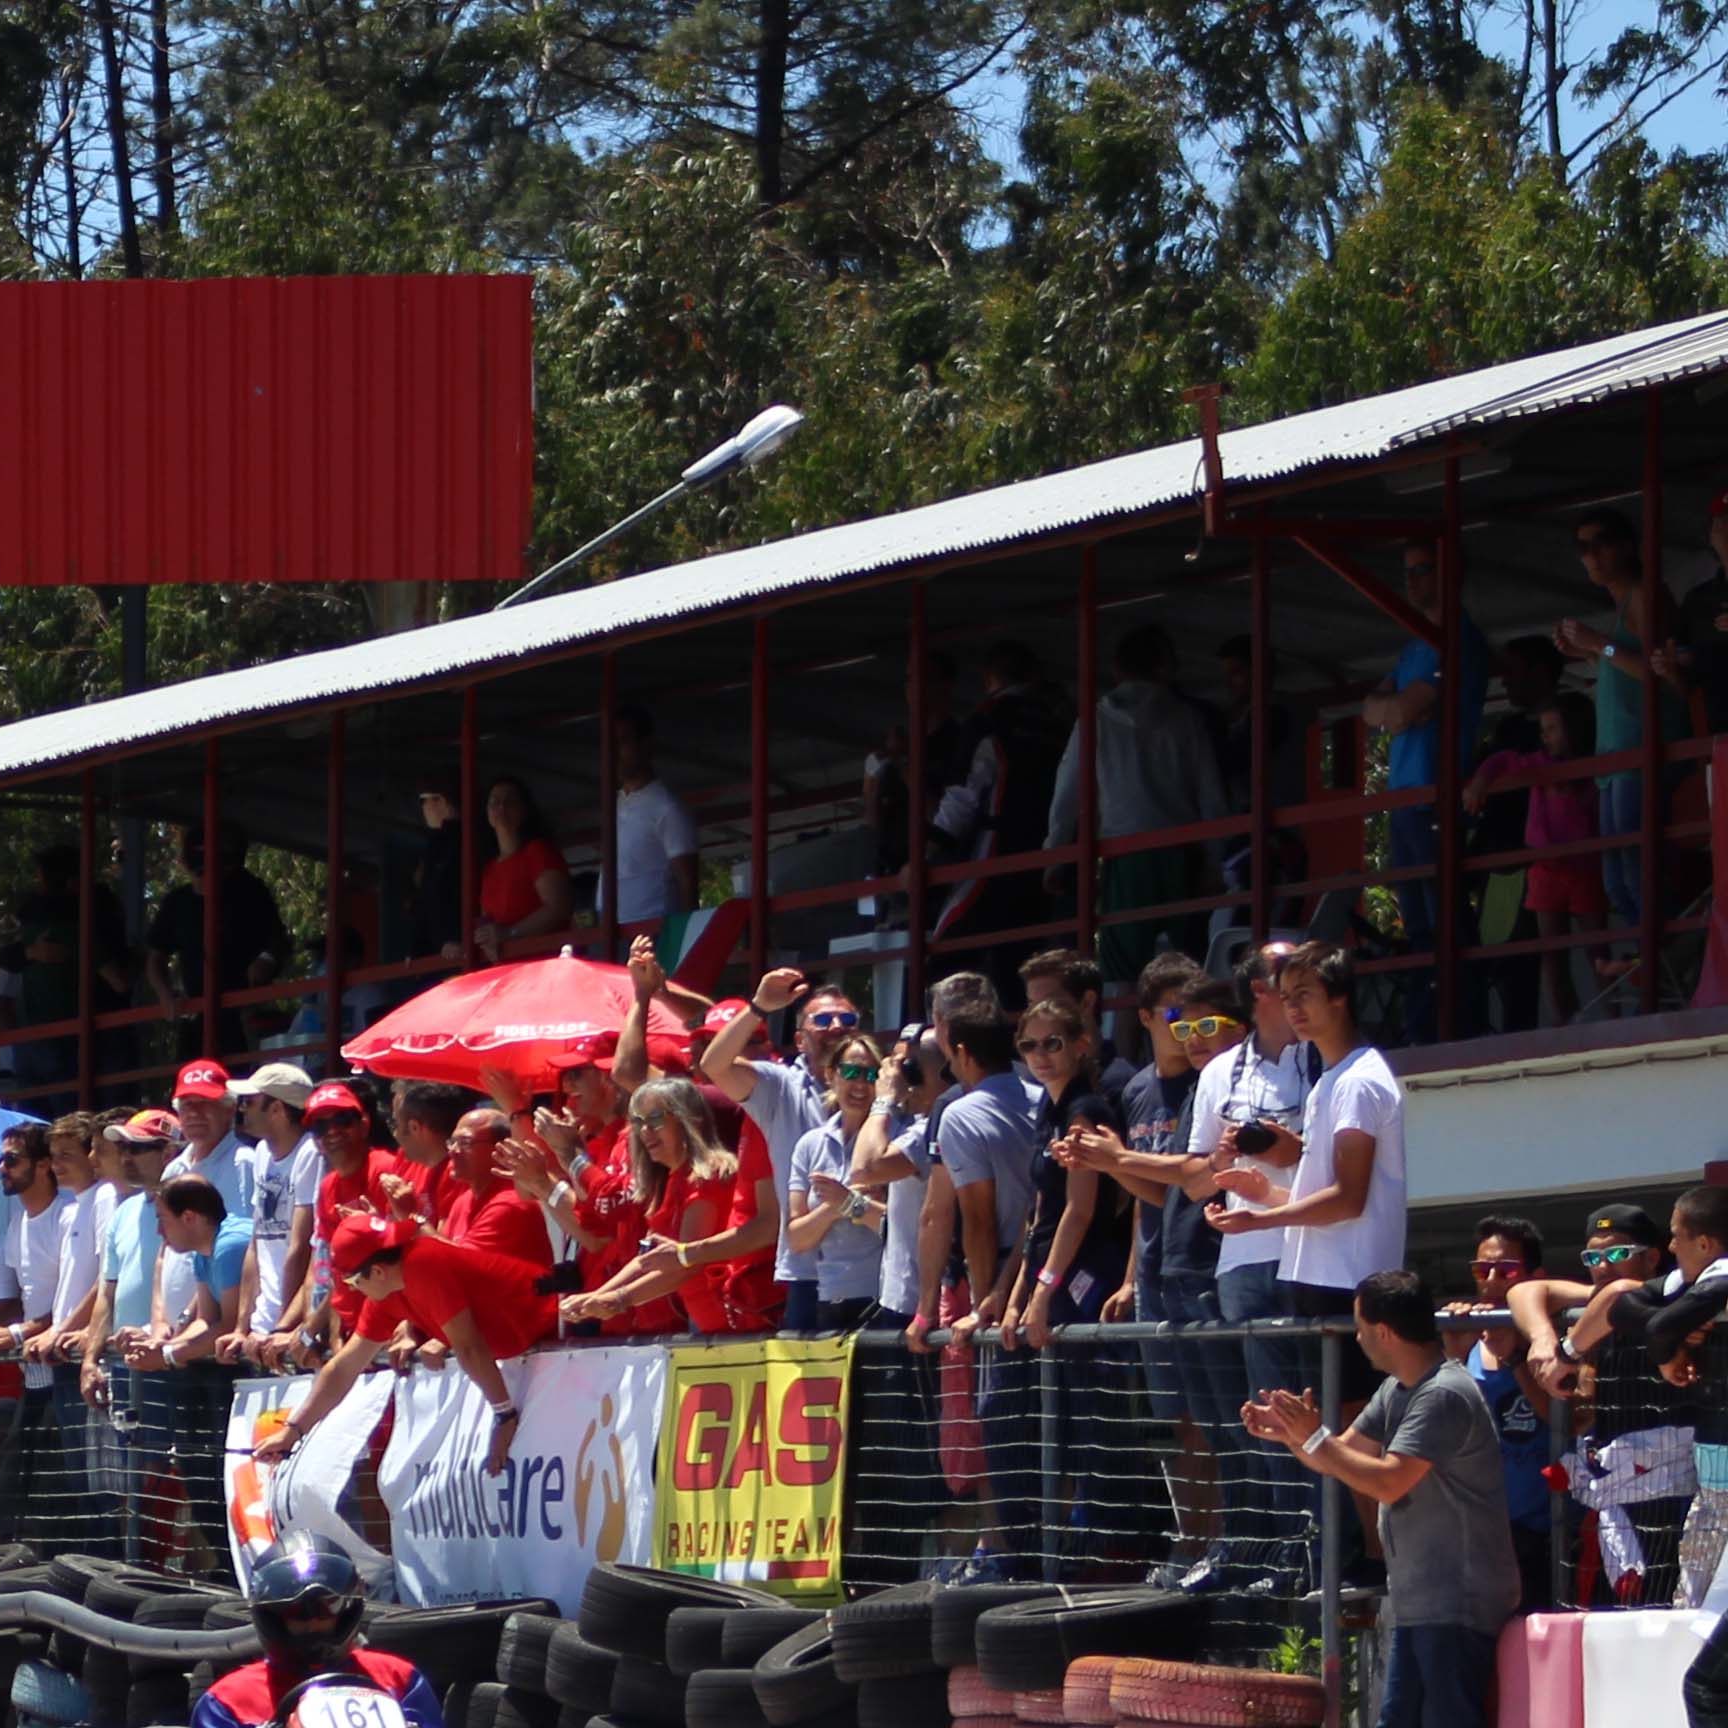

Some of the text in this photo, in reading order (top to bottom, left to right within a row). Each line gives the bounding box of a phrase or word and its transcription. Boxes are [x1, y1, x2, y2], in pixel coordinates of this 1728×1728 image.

[673, 1377, 843, 1492] GAS
[667, 1515, 837, 1560] RACING TEAM
